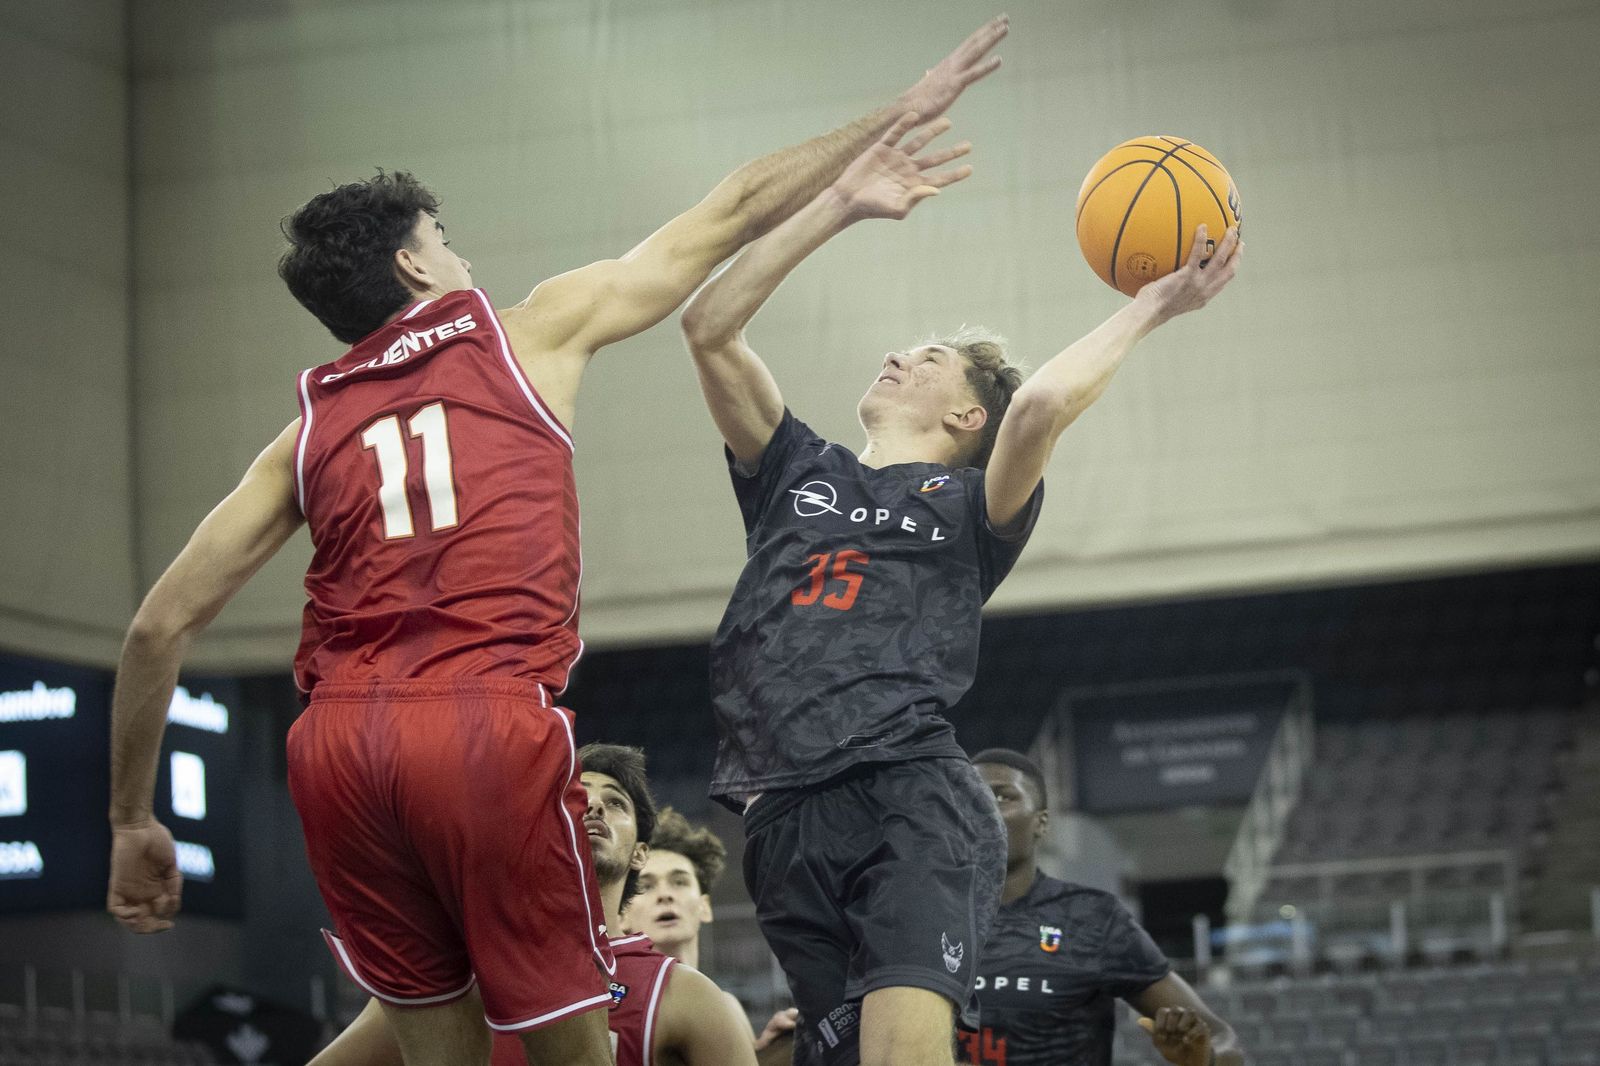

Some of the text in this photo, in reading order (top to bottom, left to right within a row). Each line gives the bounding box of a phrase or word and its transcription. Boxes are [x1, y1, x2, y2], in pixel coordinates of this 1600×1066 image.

[360, 400, 459, 540] 11
[849, 507, 945, 541] OPEL
[791, 549, 870, 611] 35
[974, 976, 1054, 994] OPEL
